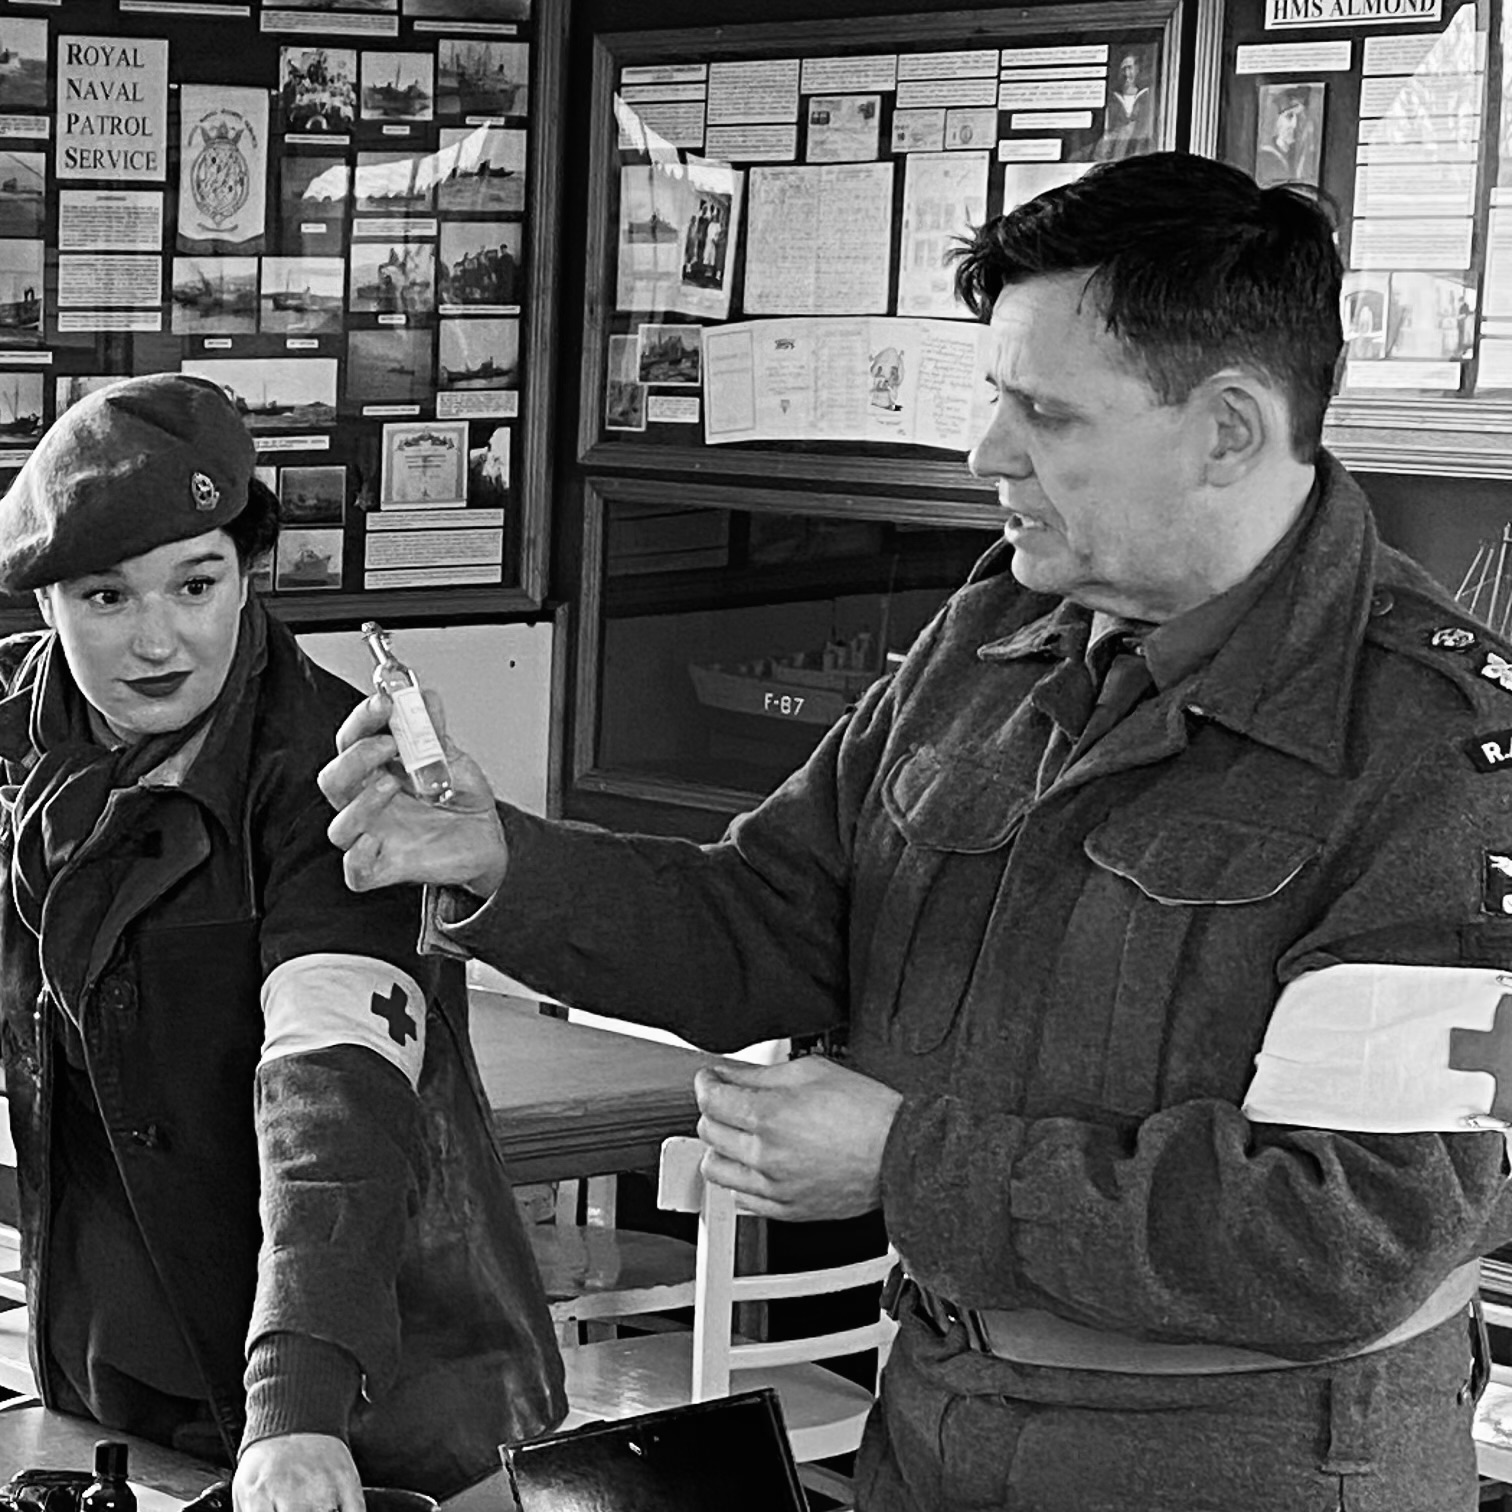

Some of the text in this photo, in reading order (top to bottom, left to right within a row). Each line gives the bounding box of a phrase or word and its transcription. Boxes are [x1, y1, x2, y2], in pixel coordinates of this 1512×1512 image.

[1273, 0, 1435, 20] HMS ALMOND
[66, 43, 145, 68] ROYAL
[66, 78, 145, 102] NAVAL
[66, 113, 153, 137] PATROL
[64, 146, 158, 171] SERVICE
[764, 692, 805, 716] F-87
